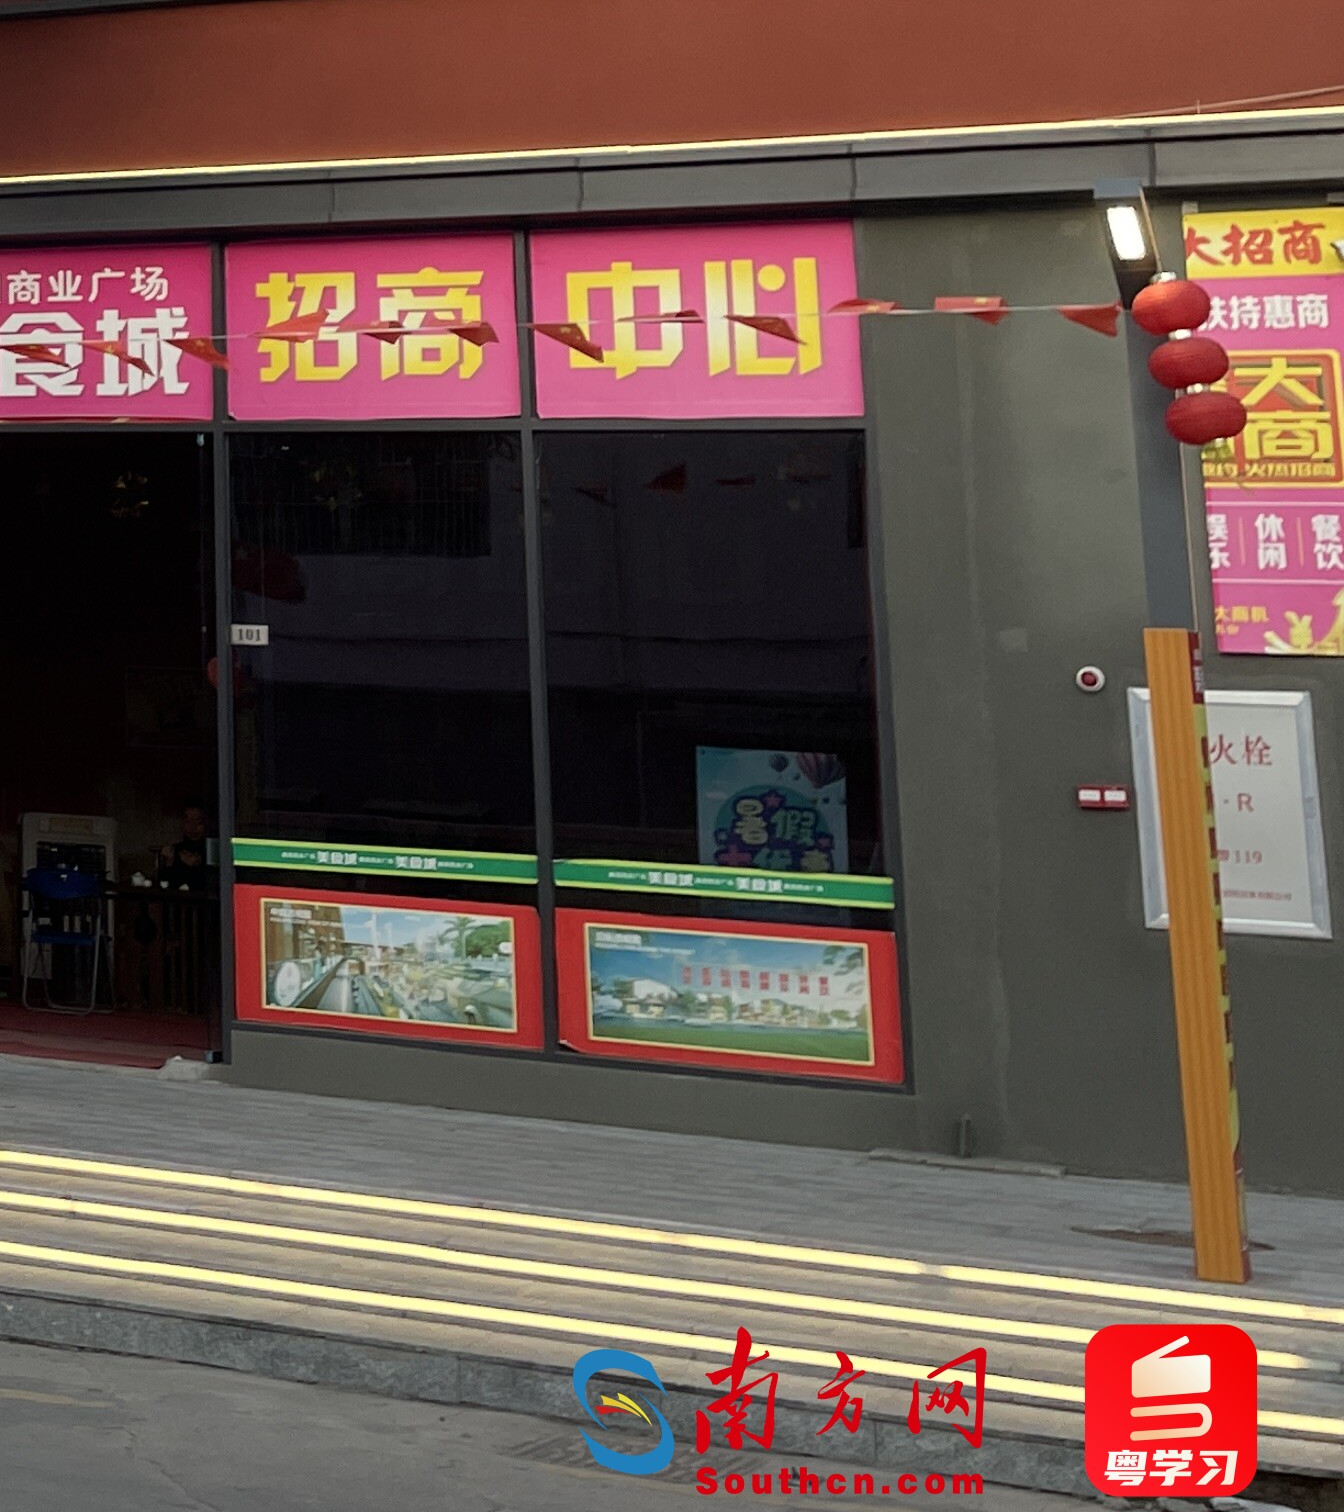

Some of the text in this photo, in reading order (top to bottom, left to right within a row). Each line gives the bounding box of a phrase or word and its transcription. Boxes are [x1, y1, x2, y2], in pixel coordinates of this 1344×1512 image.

[255, 257, 822, 382] 招商 中心
[1255, 513, 1287, 570] 休闲
[238, 628, 261, 642] 101
